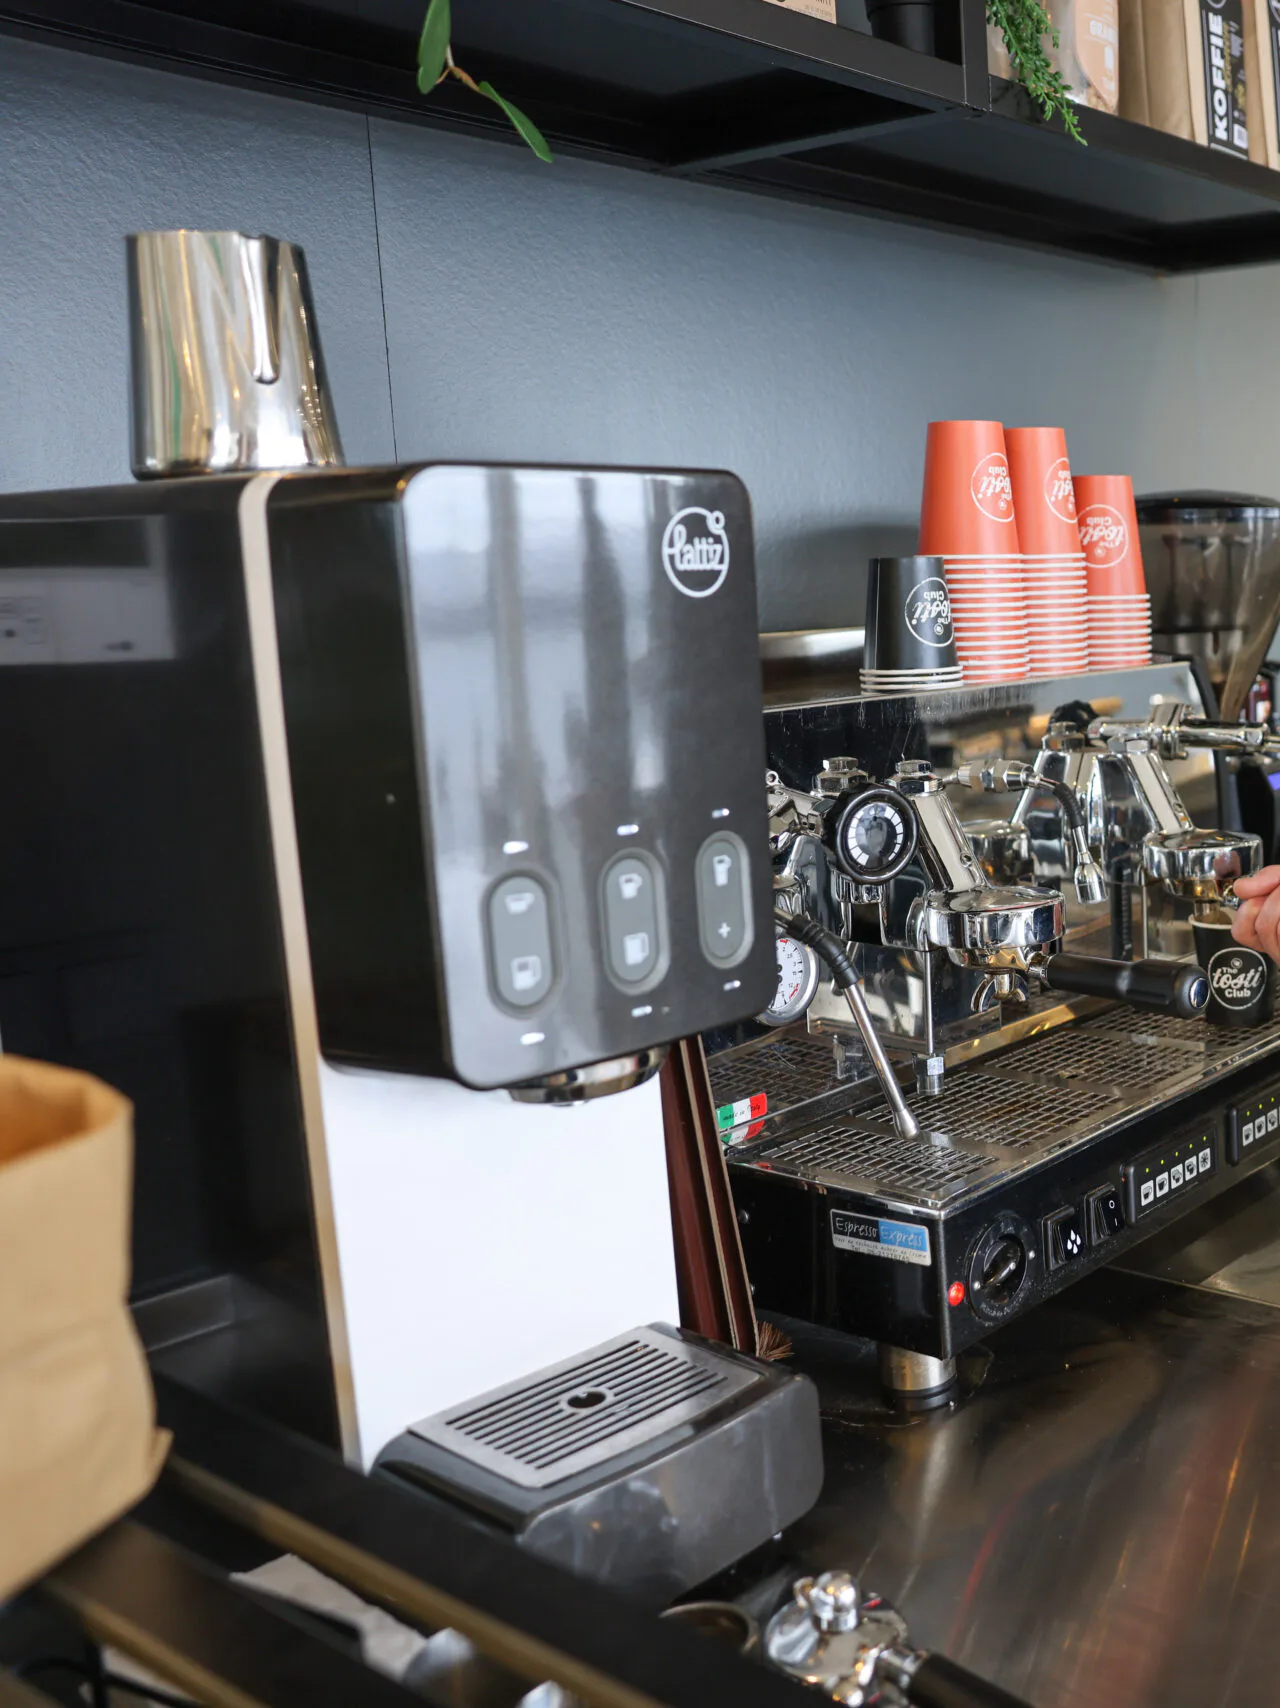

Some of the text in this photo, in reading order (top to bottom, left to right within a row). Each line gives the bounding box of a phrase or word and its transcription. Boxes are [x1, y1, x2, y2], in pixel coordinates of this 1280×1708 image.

[1208, 12, 1228, 141] KOFFIE
[1086, 516, 1112, 526] Club
[923, 590, 945, 601] Club
[1212, 965, 1263, 989] tosti
[1225, 988, 1251, 998] Club
[835, 1217, 877, 1237] Espresso
[880, 1226, 922, 1247] Express
